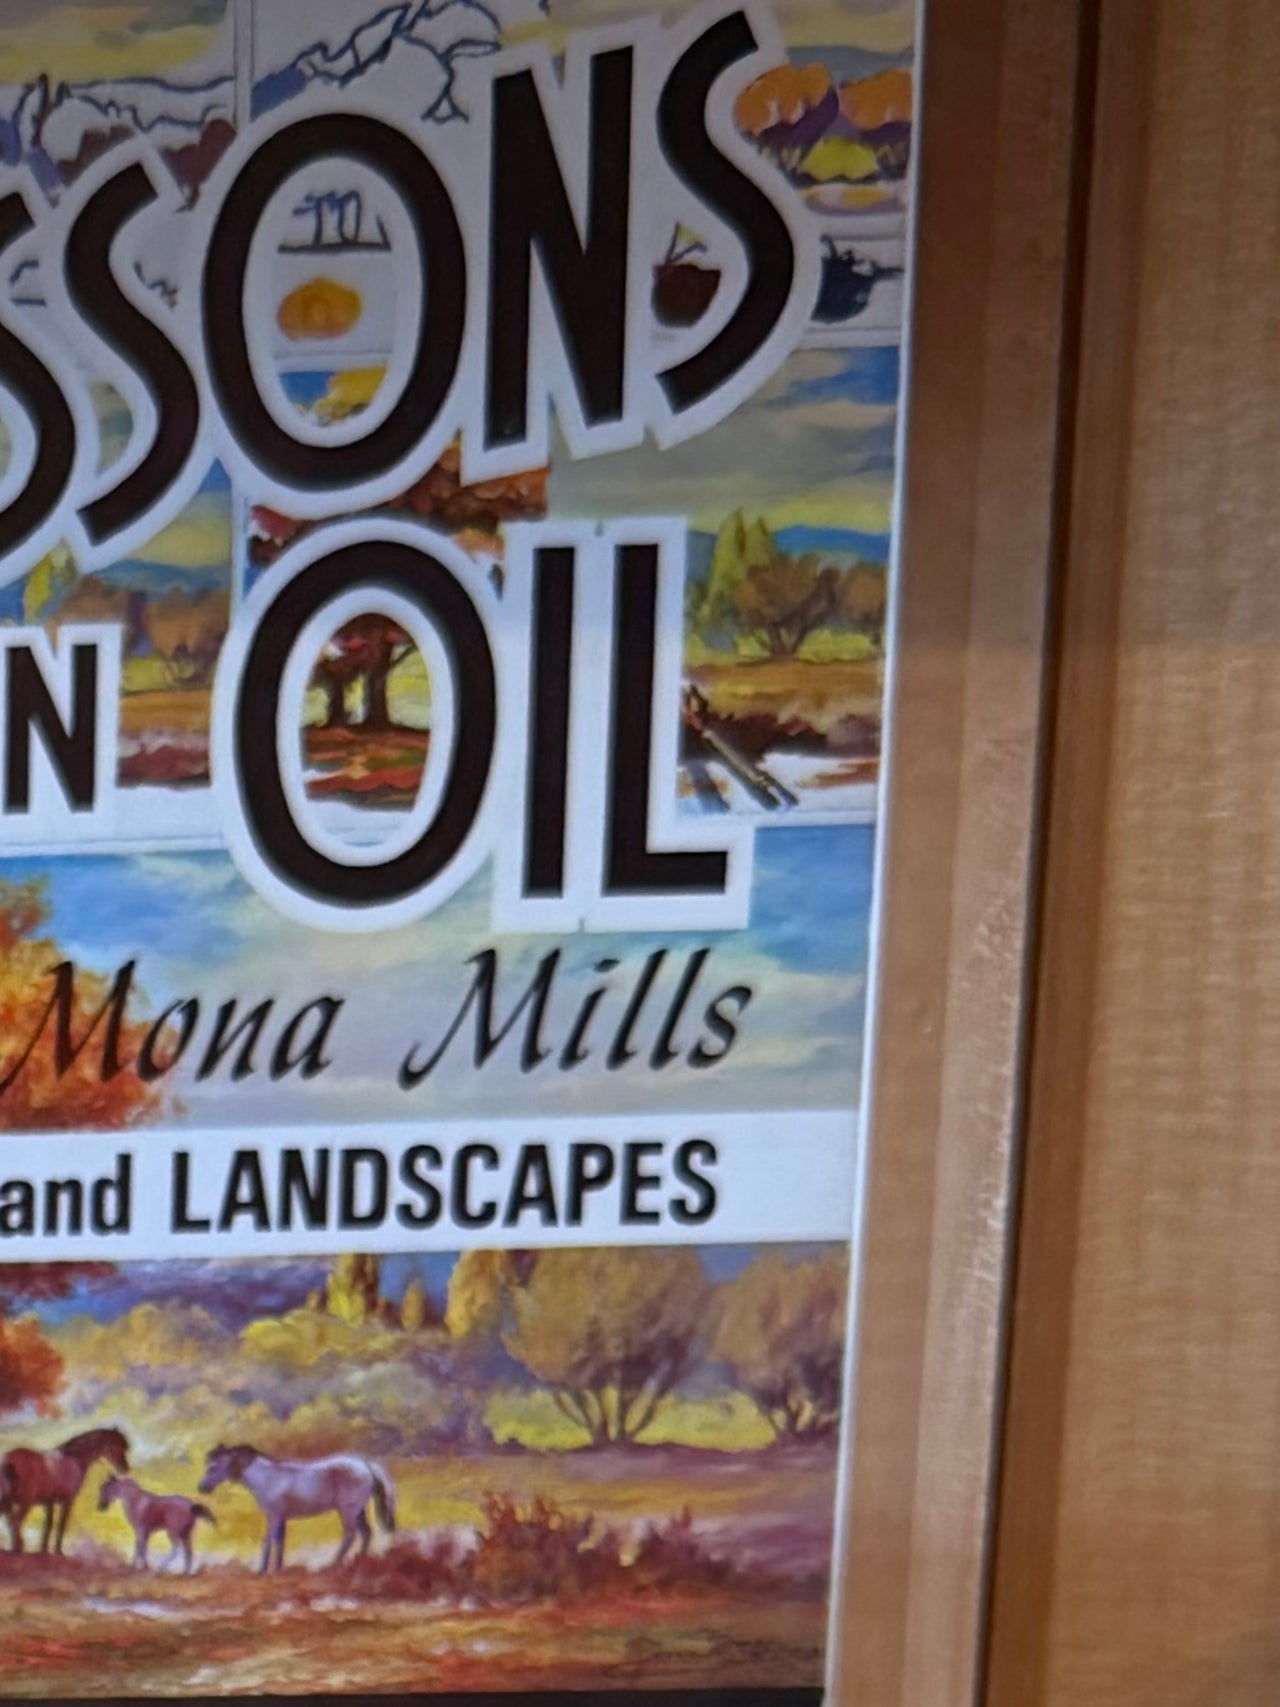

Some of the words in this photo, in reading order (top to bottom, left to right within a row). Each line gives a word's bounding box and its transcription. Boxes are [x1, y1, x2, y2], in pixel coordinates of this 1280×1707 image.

[232, 540, 731, 908] OIL
[398, 947, 756, 1090] Mills
[170, 1138, 721, 1233] LANDSCAPES
